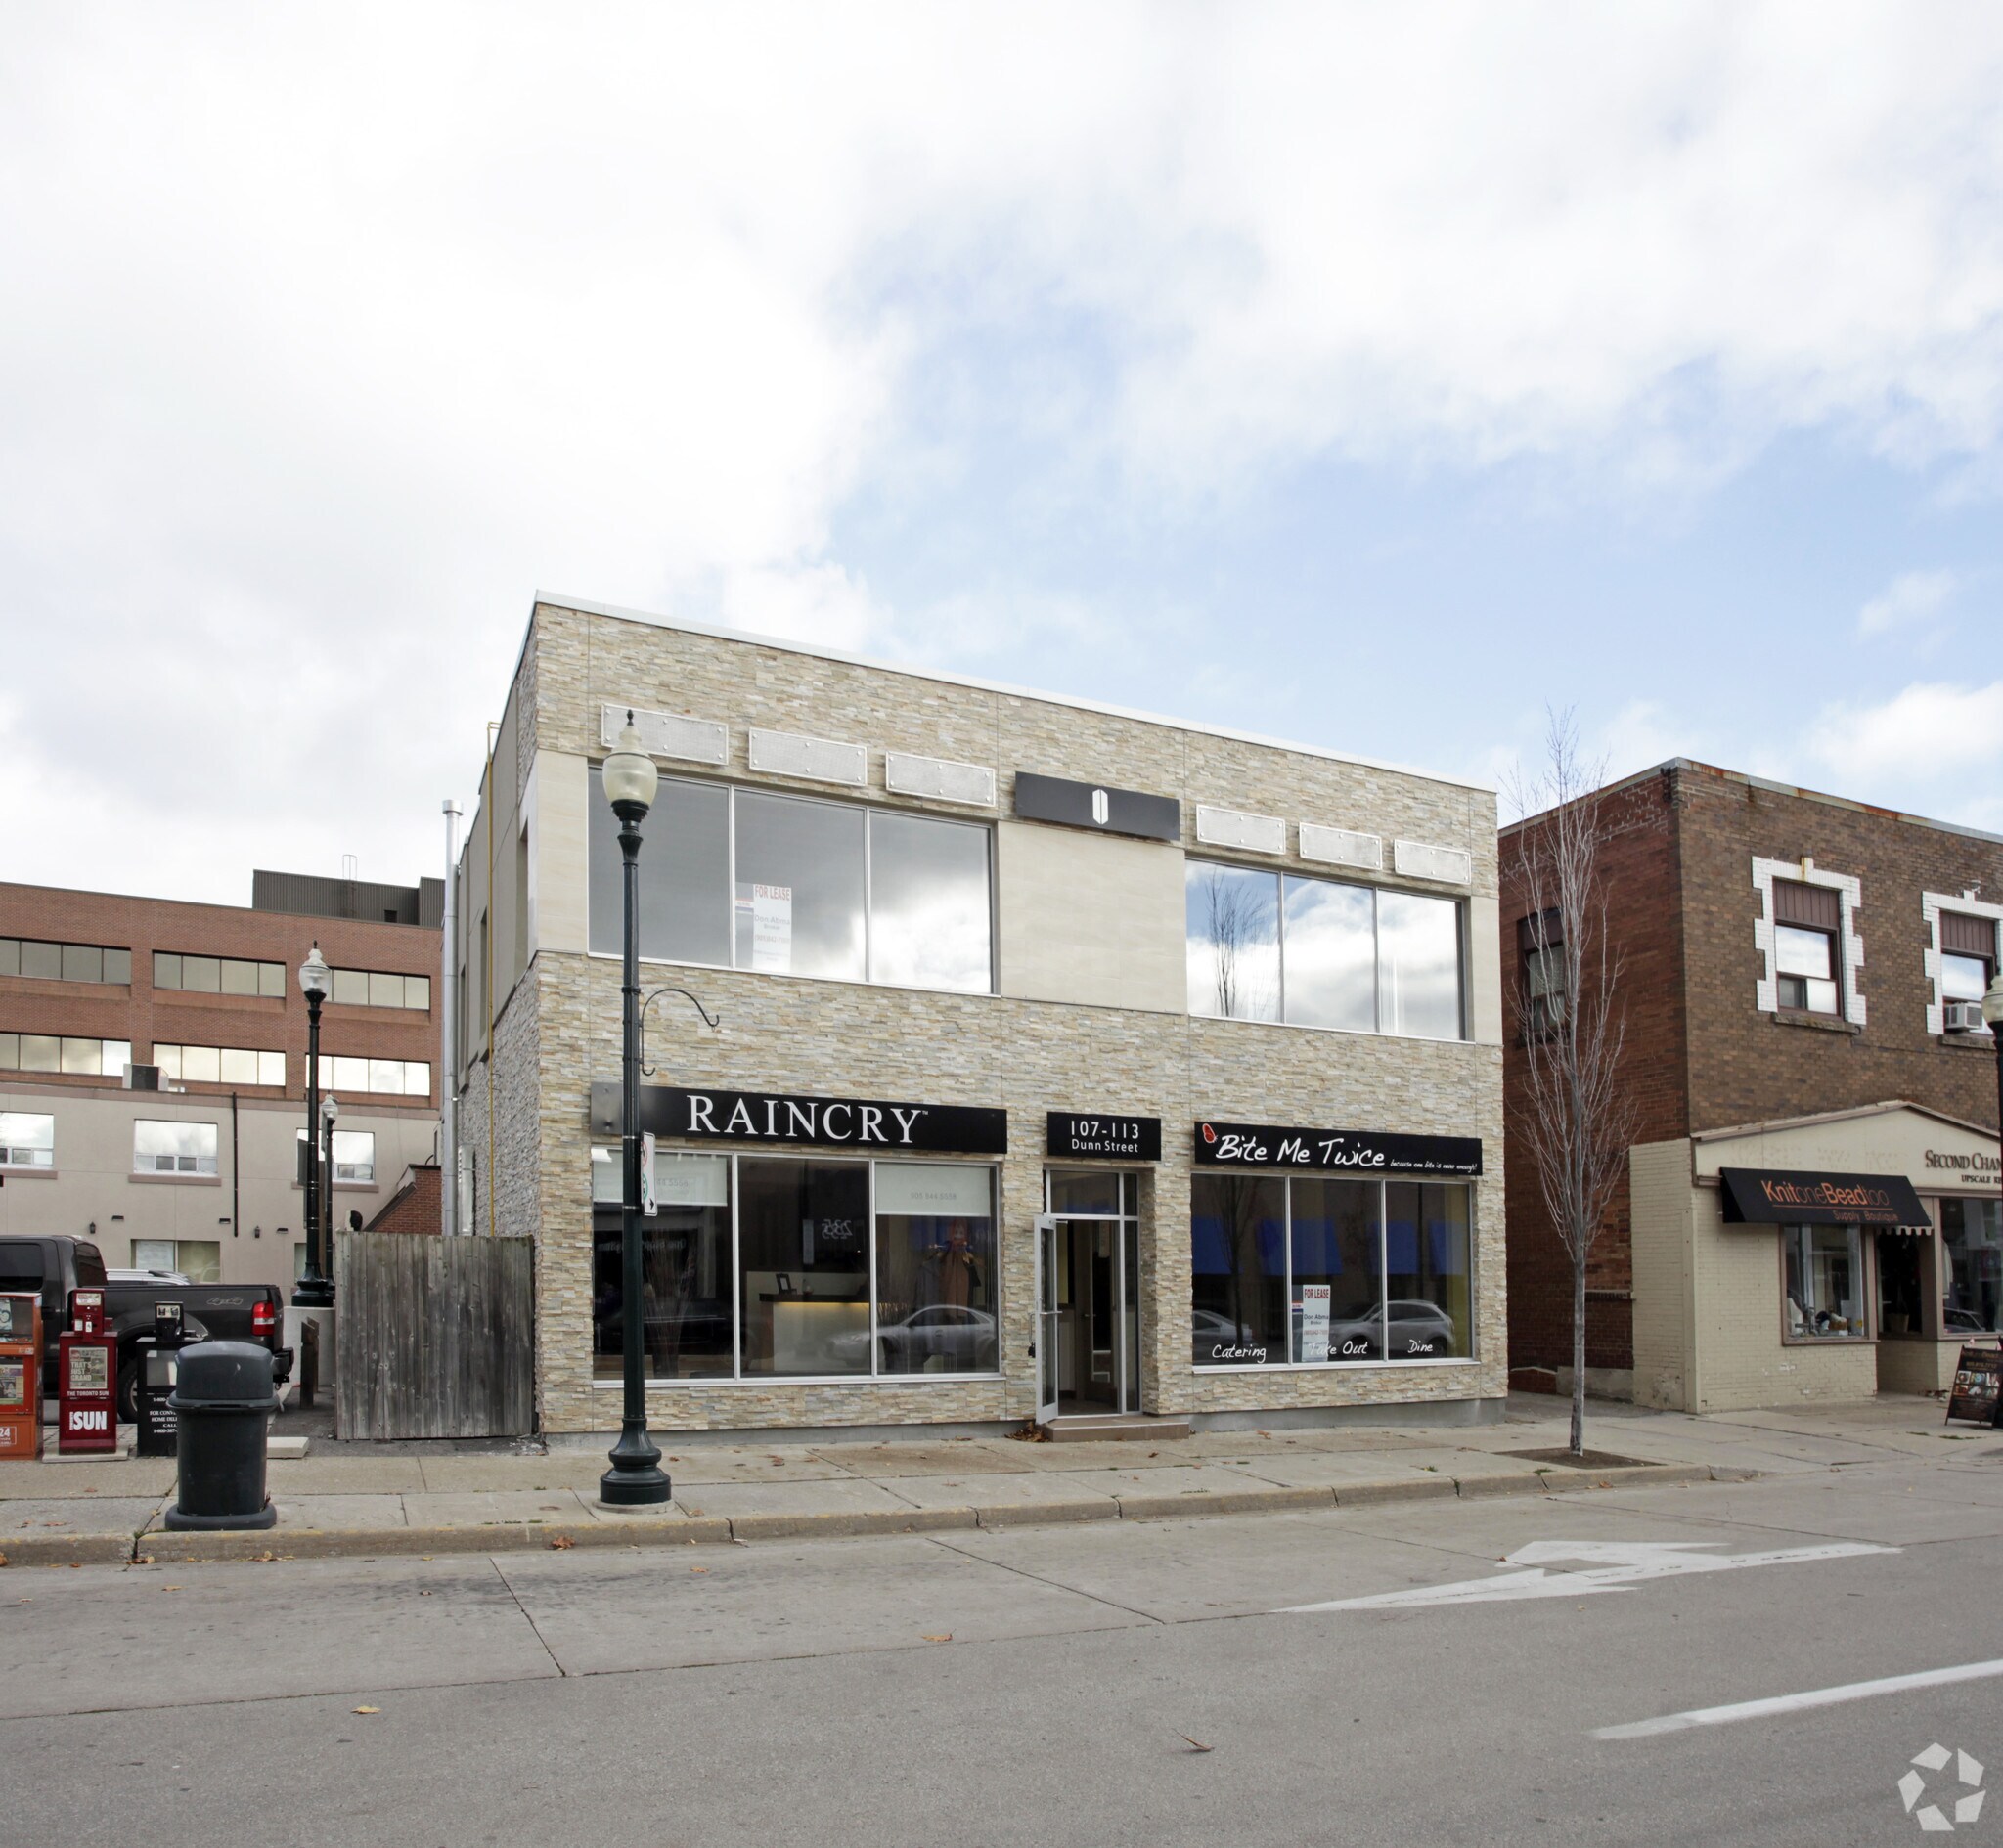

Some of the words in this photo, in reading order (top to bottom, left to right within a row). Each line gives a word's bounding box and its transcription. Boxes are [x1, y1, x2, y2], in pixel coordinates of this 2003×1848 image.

[755, 886, 768, 898] FOR
[770, 889, 790, 901] LEASE
[687, 1095, 921, 1143] RAINCRY
[1071, 1121, 1139, 1139] 107-113
[1072, 1139, 1101, 1150] Dunn
[1104, 1141, 1138, 1153] Street
[1216, 1135, 1268, 1161] Bite
[1277, 1137, 1311, 1163] Me
[1318, 1138, 1385, 1166] Twice
[1390, 1159, 1412, 1167] because
[1456, 1164, 1477, 1172] enough!
[1961, 1174, 1991, 1183] UPSCALE
[1833, 1210, 1860, 1222] Supply
[1863, 1211, 1899, 1222] Boutique
[1304, 1288, 1313, 1299] FOR
[1314, 1288, 1329, 1299] LEASE
[1309, 1340, 1337, 1357] Take
[1342, 1341, 1368, 1355] Out
[1408, 1339, 1434, 1353] Dine
[1212, 1344, 1267, 1364] Catering
[73, 1411, 108, 1430] SUN
